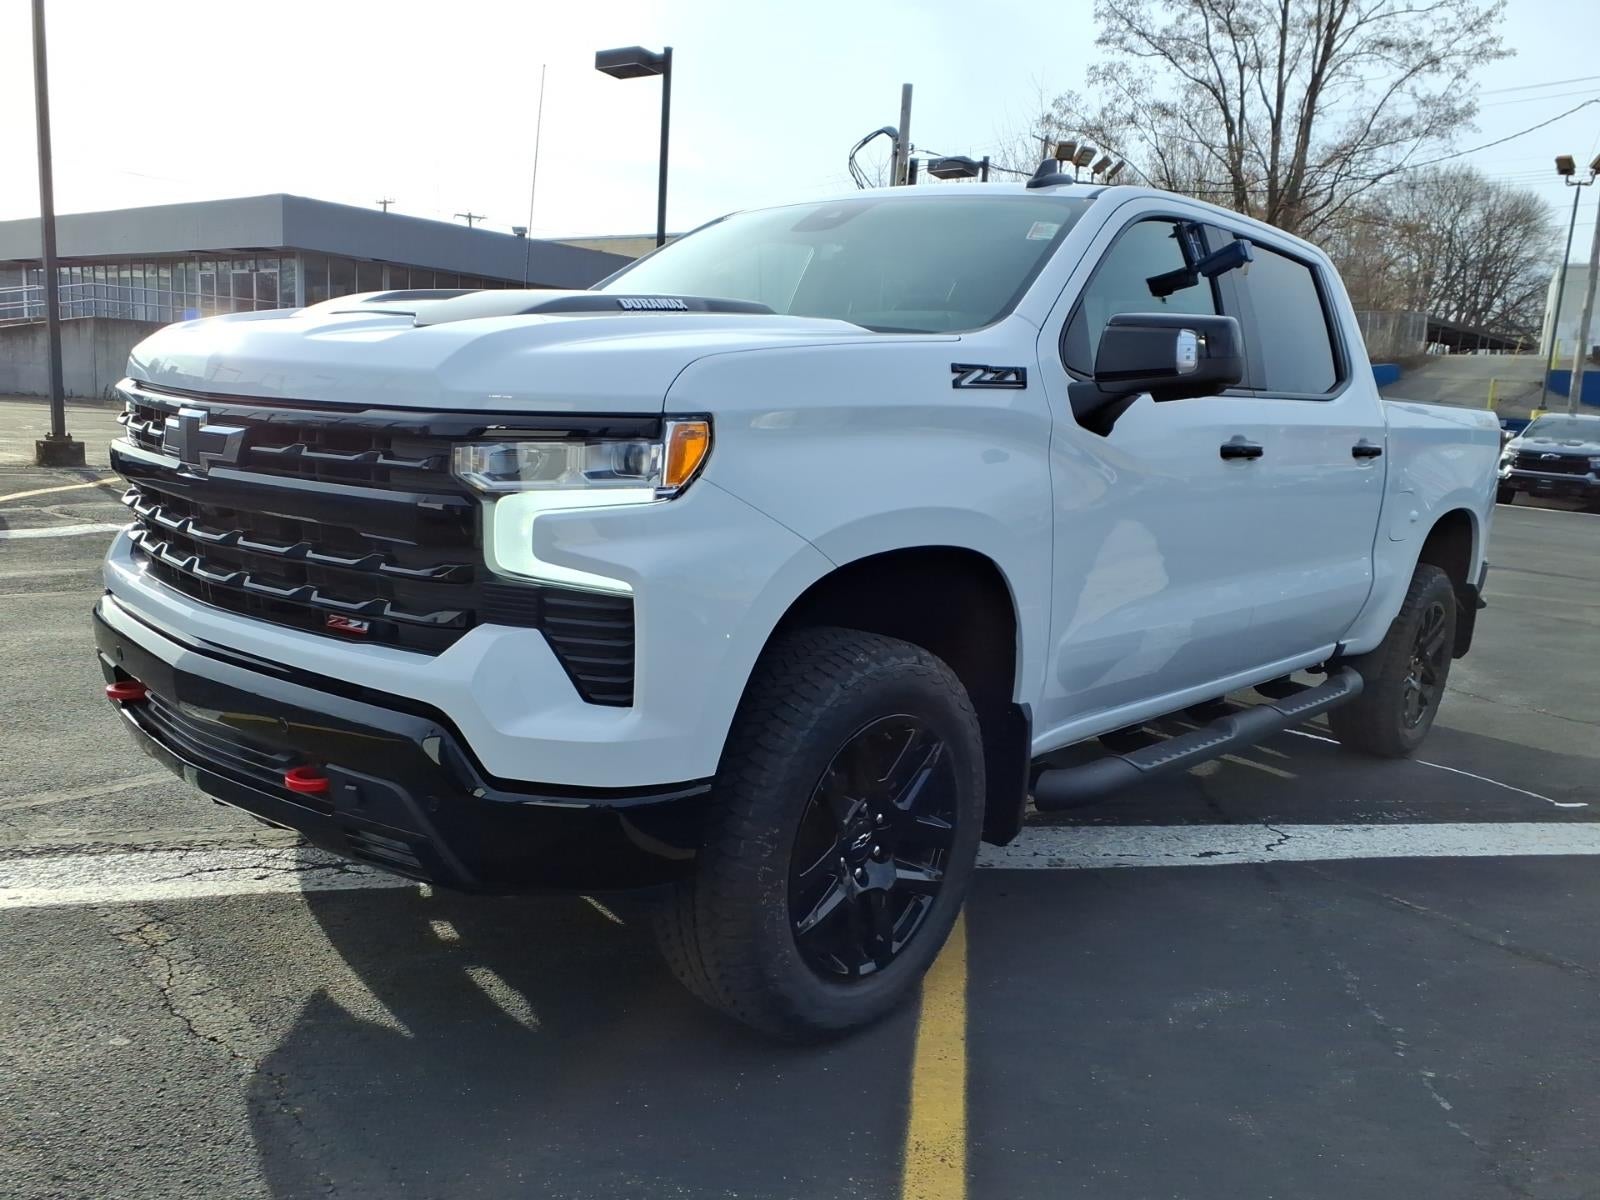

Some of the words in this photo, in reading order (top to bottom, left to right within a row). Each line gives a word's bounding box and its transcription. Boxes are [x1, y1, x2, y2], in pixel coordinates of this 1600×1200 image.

[617, 298, 688, 310] DURAMAX
[951, 363, 1027, 389] Z71
[328, 614, 369, 633] Z71
